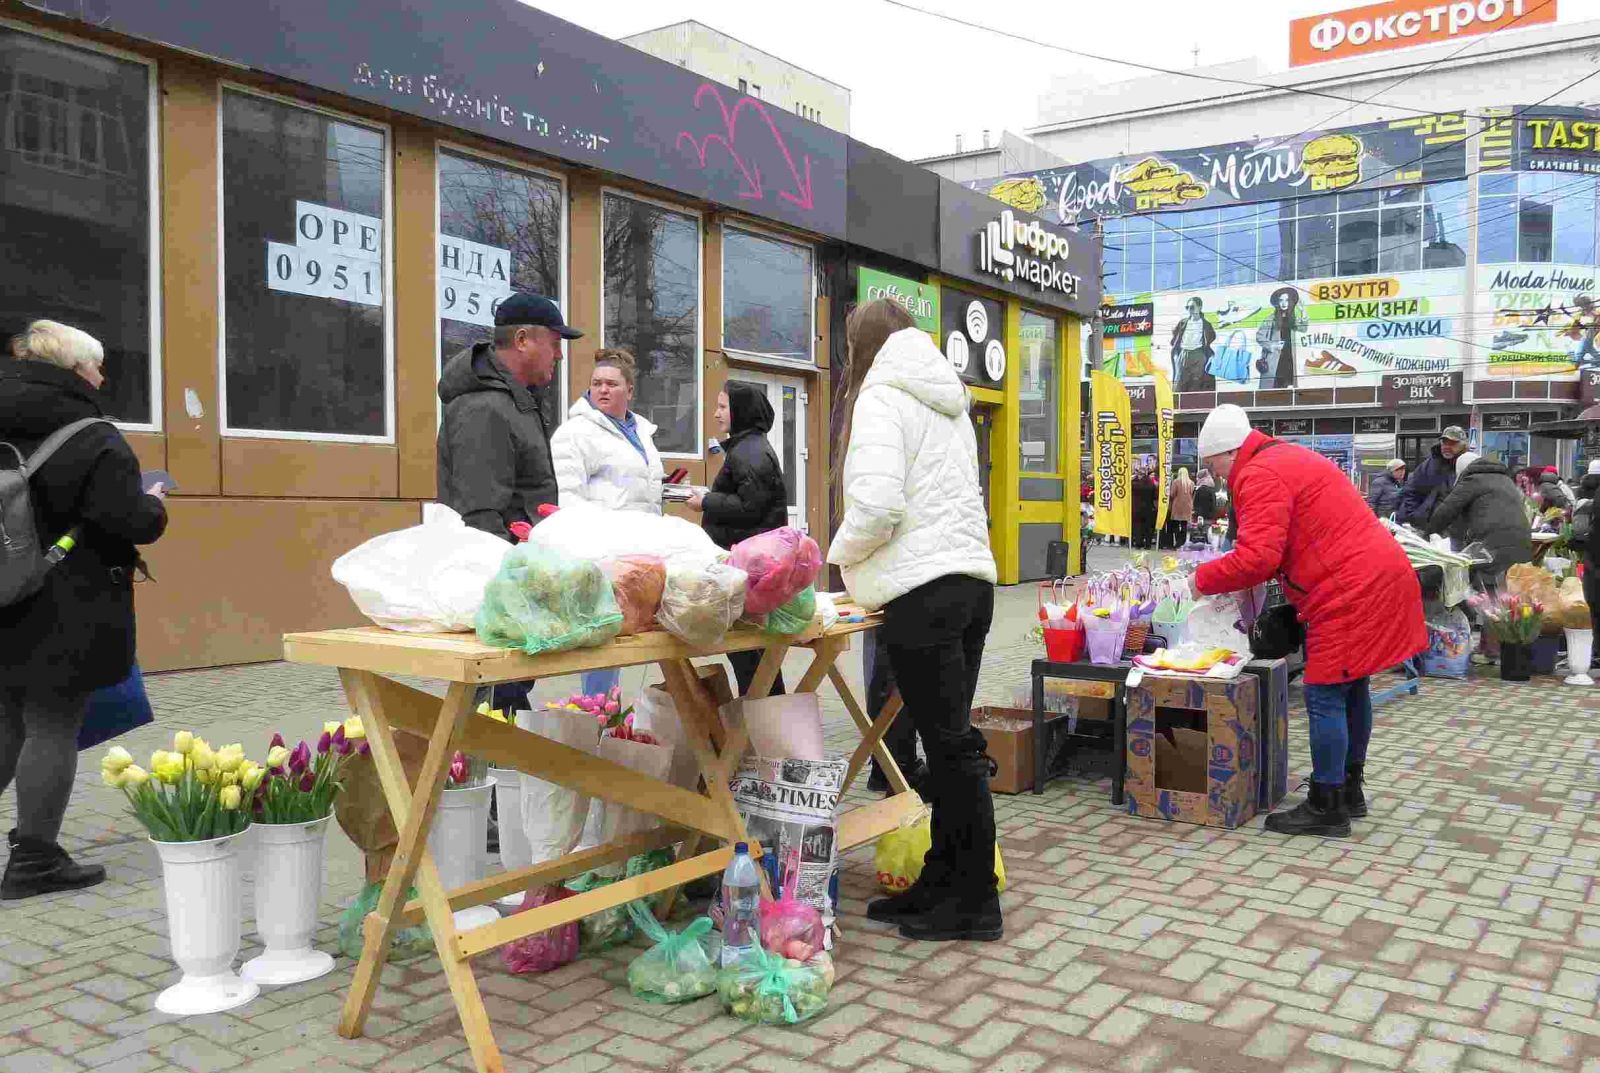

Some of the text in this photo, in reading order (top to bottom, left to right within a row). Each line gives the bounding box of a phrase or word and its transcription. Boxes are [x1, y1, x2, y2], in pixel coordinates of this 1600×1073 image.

[299, 213, 506, 282] ОРЕ НДА
[276, 253, 375, 295] 0951
[1490, 269, 1595, 291] Moda House
[1318, 281, 1389, 300] ВЗУТТЯ
[1335, 299, 1418, 320] БІЛИЗНА
[1366, 320, 1441, 338] СУМКИ
[1300, 333, 1334, 347] СТИЛЬ
[1336, 336, 1394, 367] ДОСТУПНИЙ
[777, 787, 838, 811] TIMES
